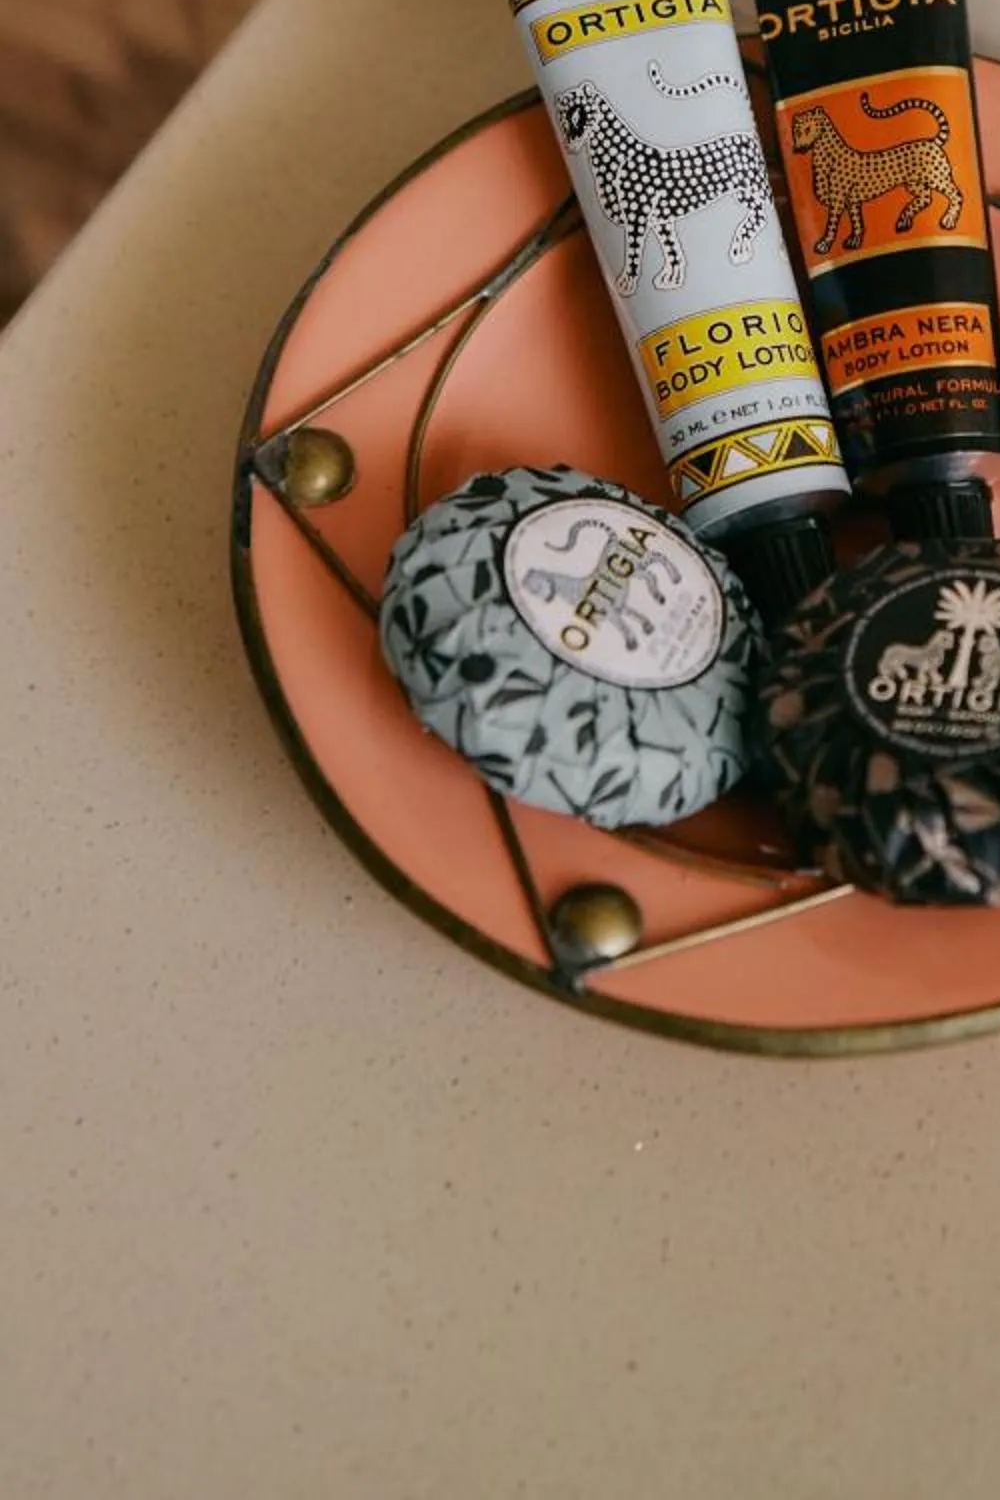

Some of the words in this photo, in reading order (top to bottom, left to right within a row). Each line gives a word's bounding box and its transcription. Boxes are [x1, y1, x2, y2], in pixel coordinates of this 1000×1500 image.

[817, 13, 895, 42] SICILIA
[654, 311, 804, 367] FLORIO
[826, 323, 905, 359] AMBRA
[916, 314, 985, 334] NERA
[844, 352, 890, 377] BODY
[898, 338, 969, 361] LOTION
[655, 355, 725, 401] BODY
[730, 401, 760, 420] NET
[560, 525, 657, 652] ORTIGIA
